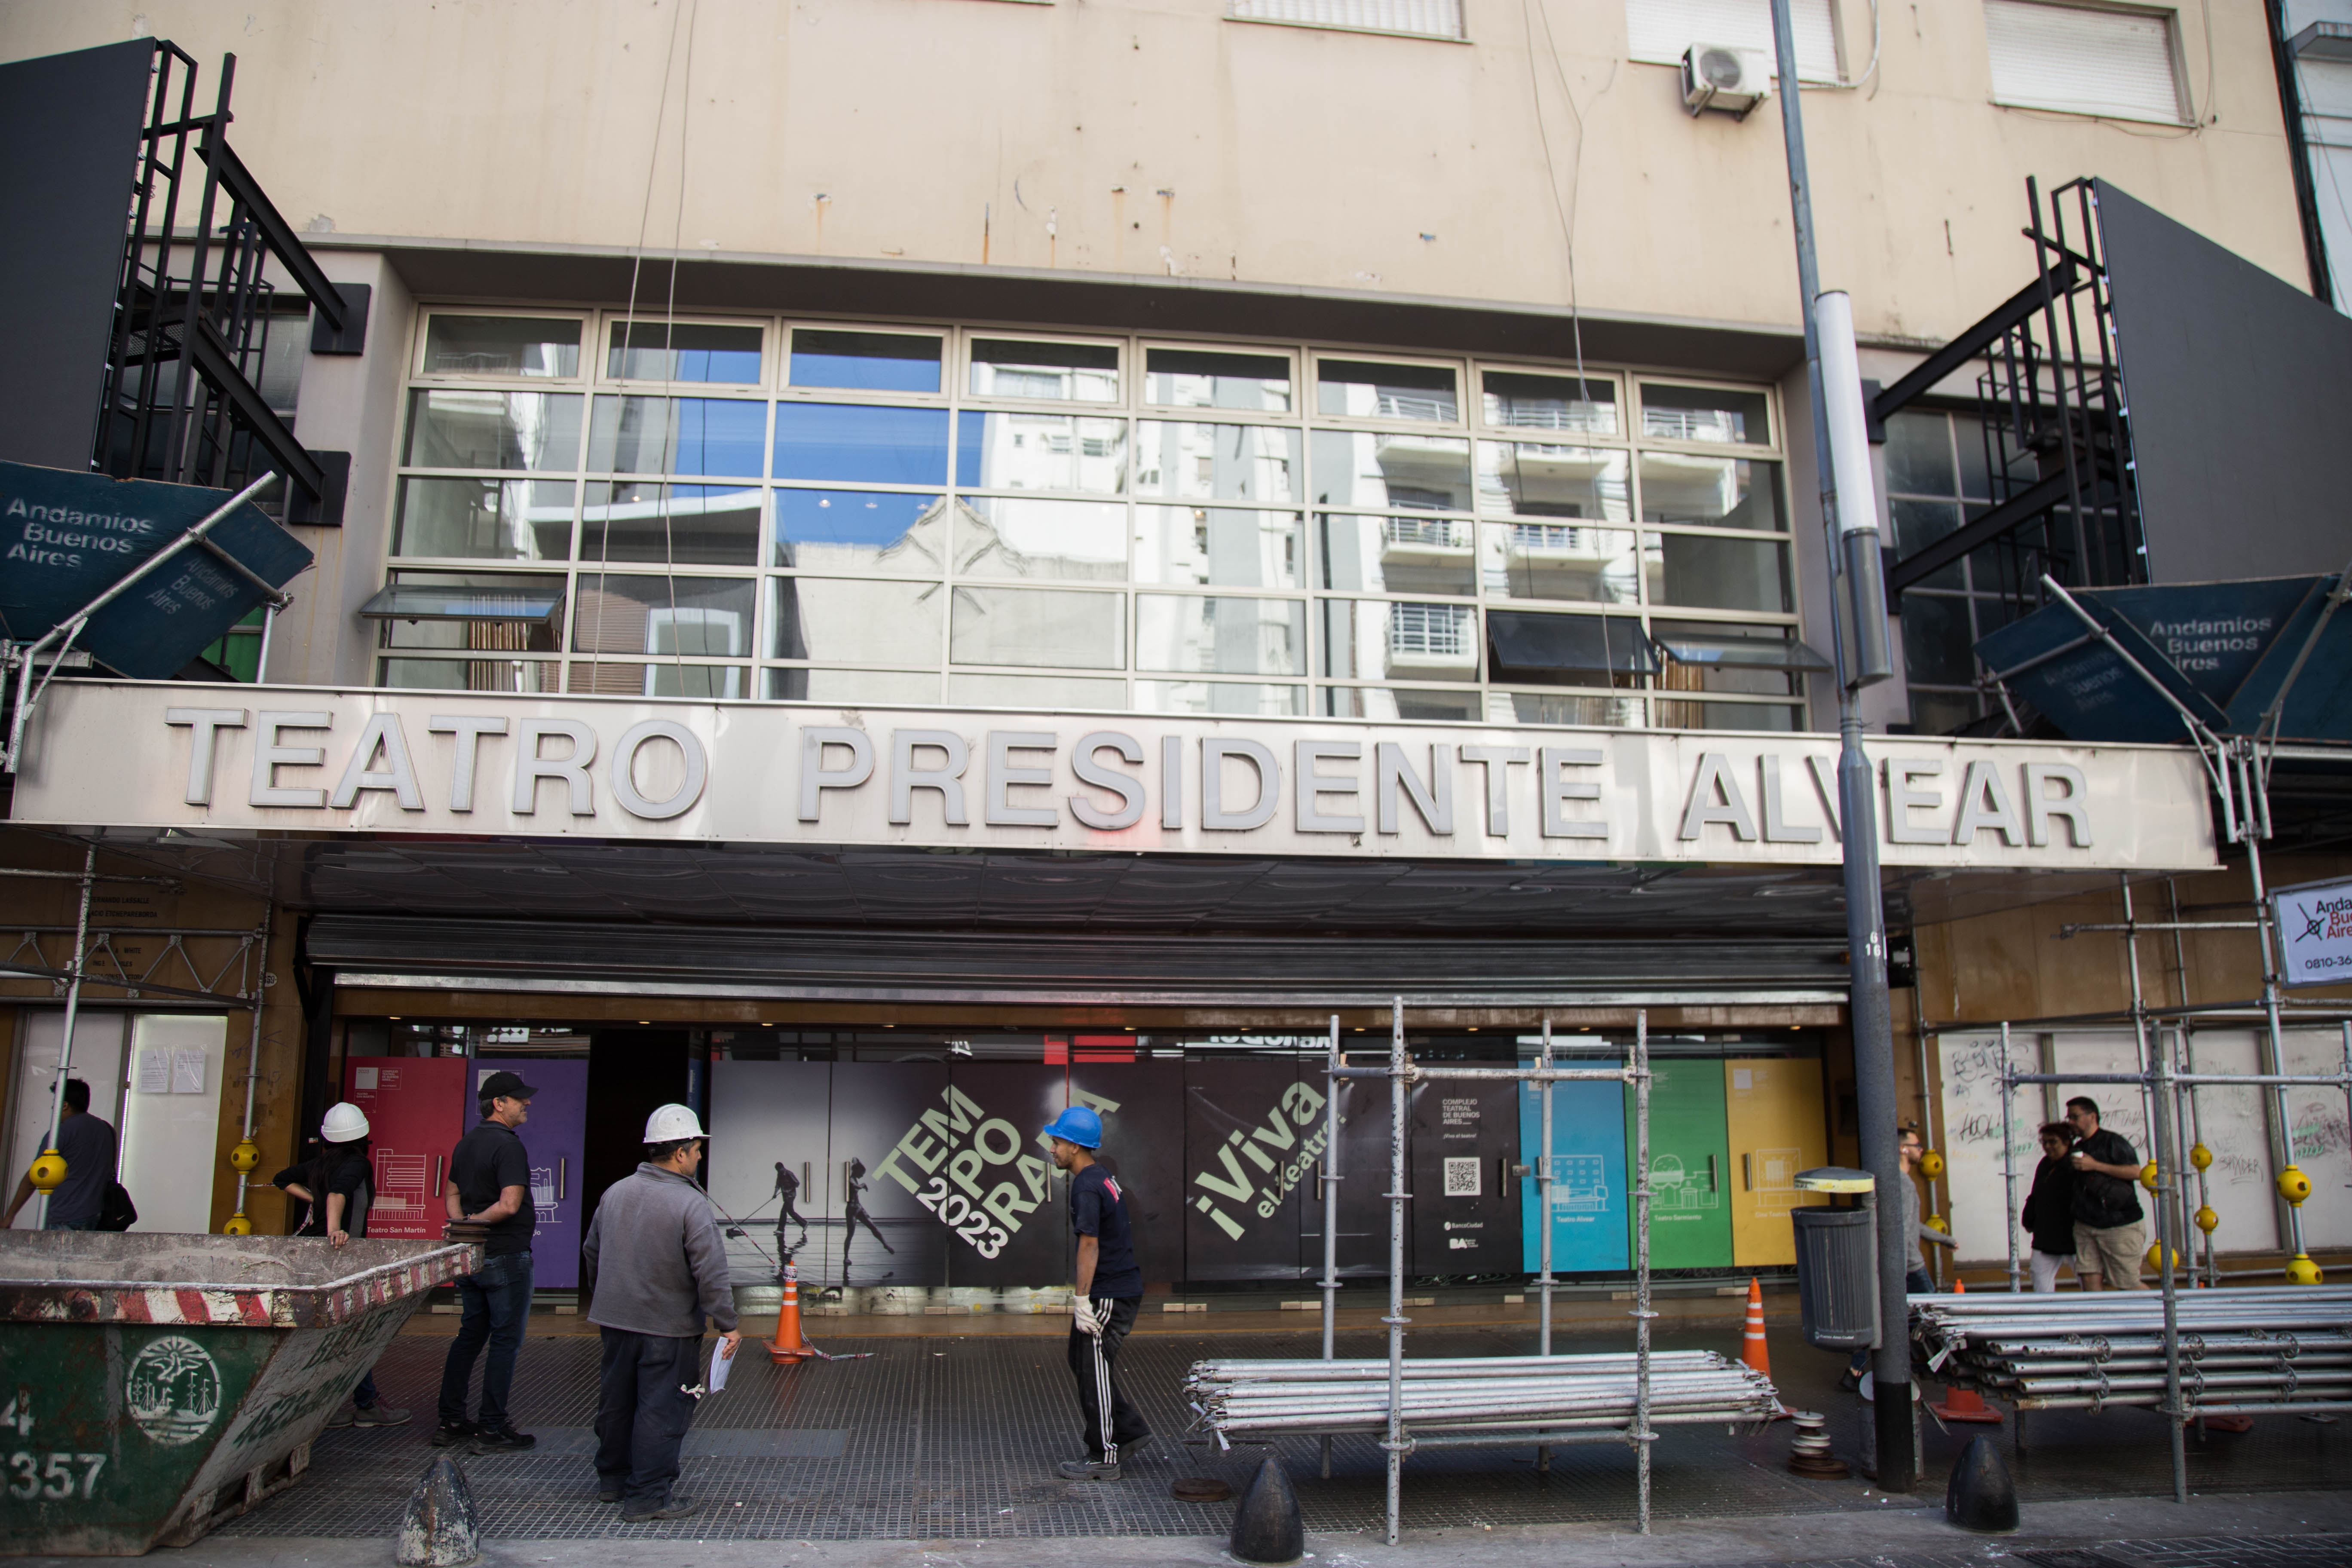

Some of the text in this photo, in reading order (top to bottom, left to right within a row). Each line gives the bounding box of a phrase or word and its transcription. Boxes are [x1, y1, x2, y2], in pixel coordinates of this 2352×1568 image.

[7, 498, 154, 533] Andamios
[24, 522, 133, 553] Buenos
[7, 543, 82, 567] Aires
[145, 588, 181, 614] Aires
[171, 574, 215, 609] Buenos
[2150, 616, 2272, 637] Andamios
[2168, 637, 2259, 654] Buenos
[2175, 655, 2220, 671] ires
[164, 705, 708, 821] TEATRO
[798, 725, 1610, 840] PRESIDENTE
[1865, 943, 1881, 957] 16
[1870, 931, 1878, 944] 6
[872, 1088, 985, 1200] TEM
[943, 1123, 1021, 1205] PO
[982, 1092, 1121, 1238] RAA
[1194, 1081, 1327, 1241] ¡Viva
[1257, 1187, 1282, 1218] el
[916, 1181, 1009, 1264] 2023
[0, 1452, 107, 1500] 357
